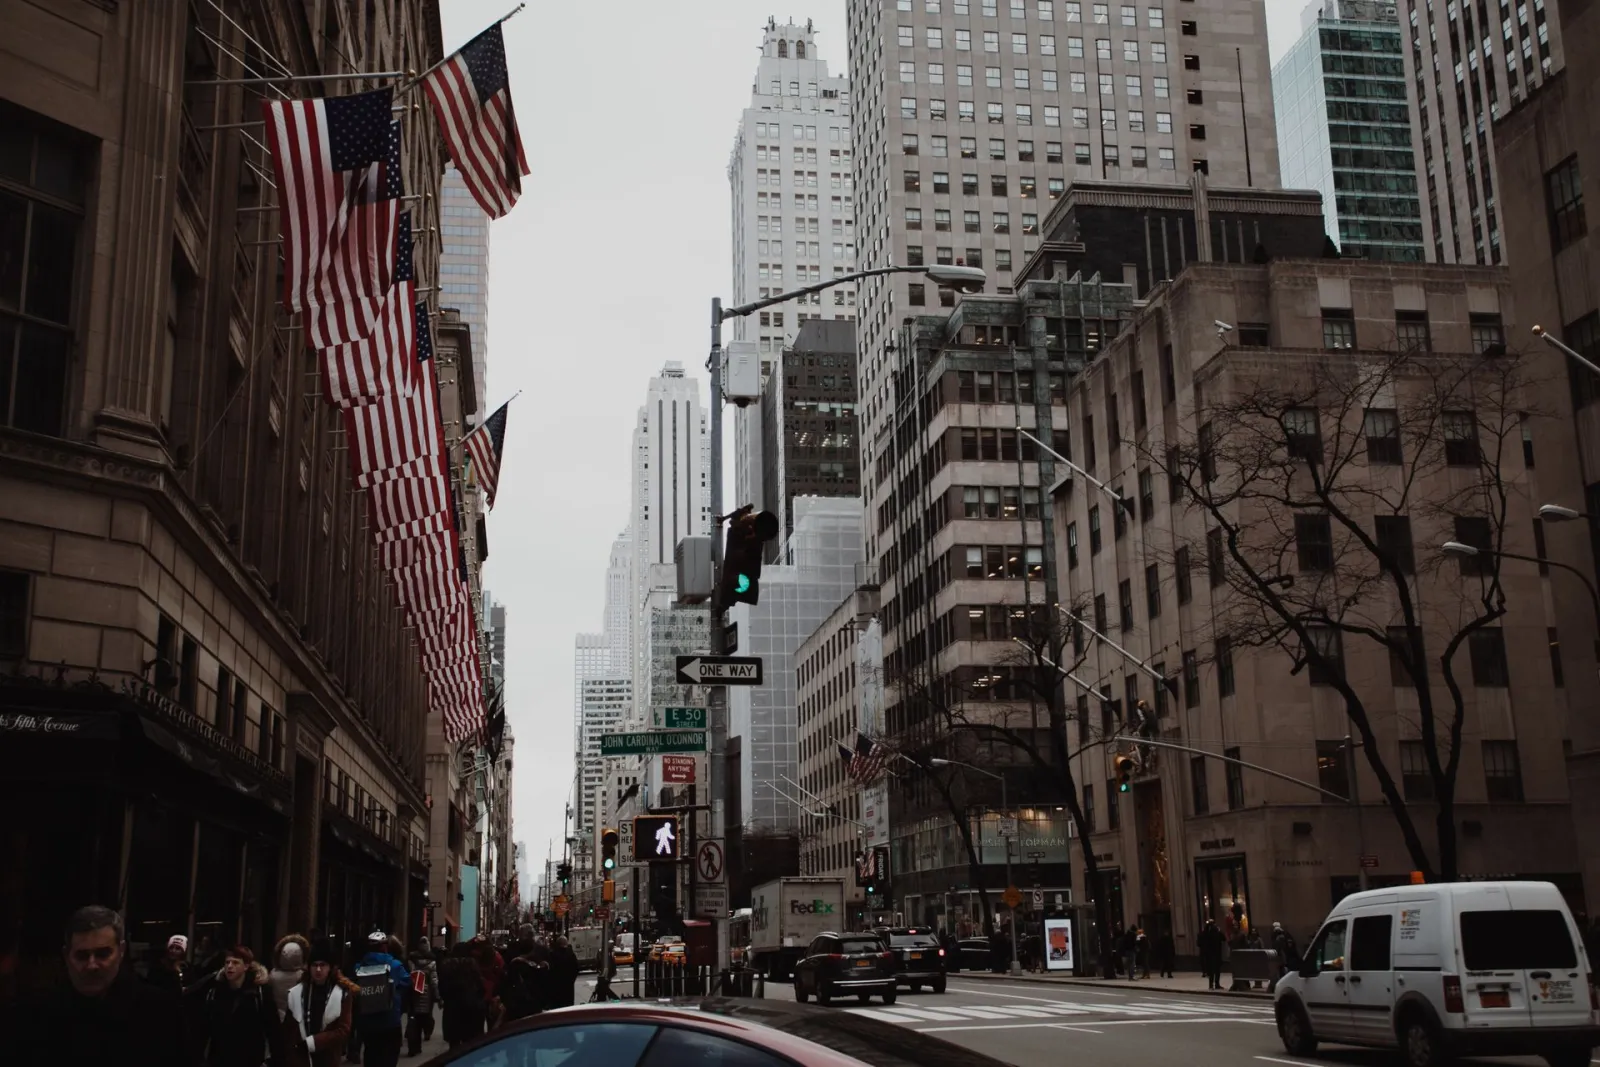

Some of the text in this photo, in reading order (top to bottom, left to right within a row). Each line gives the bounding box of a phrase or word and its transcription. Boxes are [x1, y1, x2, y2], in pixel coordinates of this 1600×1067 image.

[700, 664, 754, 677] ONE WAY
[672, 709, 701, 720] E 50
[603, 732, 704, 748] JOHN CARDINAL O'CONNOR
[672, 757, 694, 766] STANDING
[791, 899, 833, 914] FedEx
[361, 985, 386, 997] RELAY
